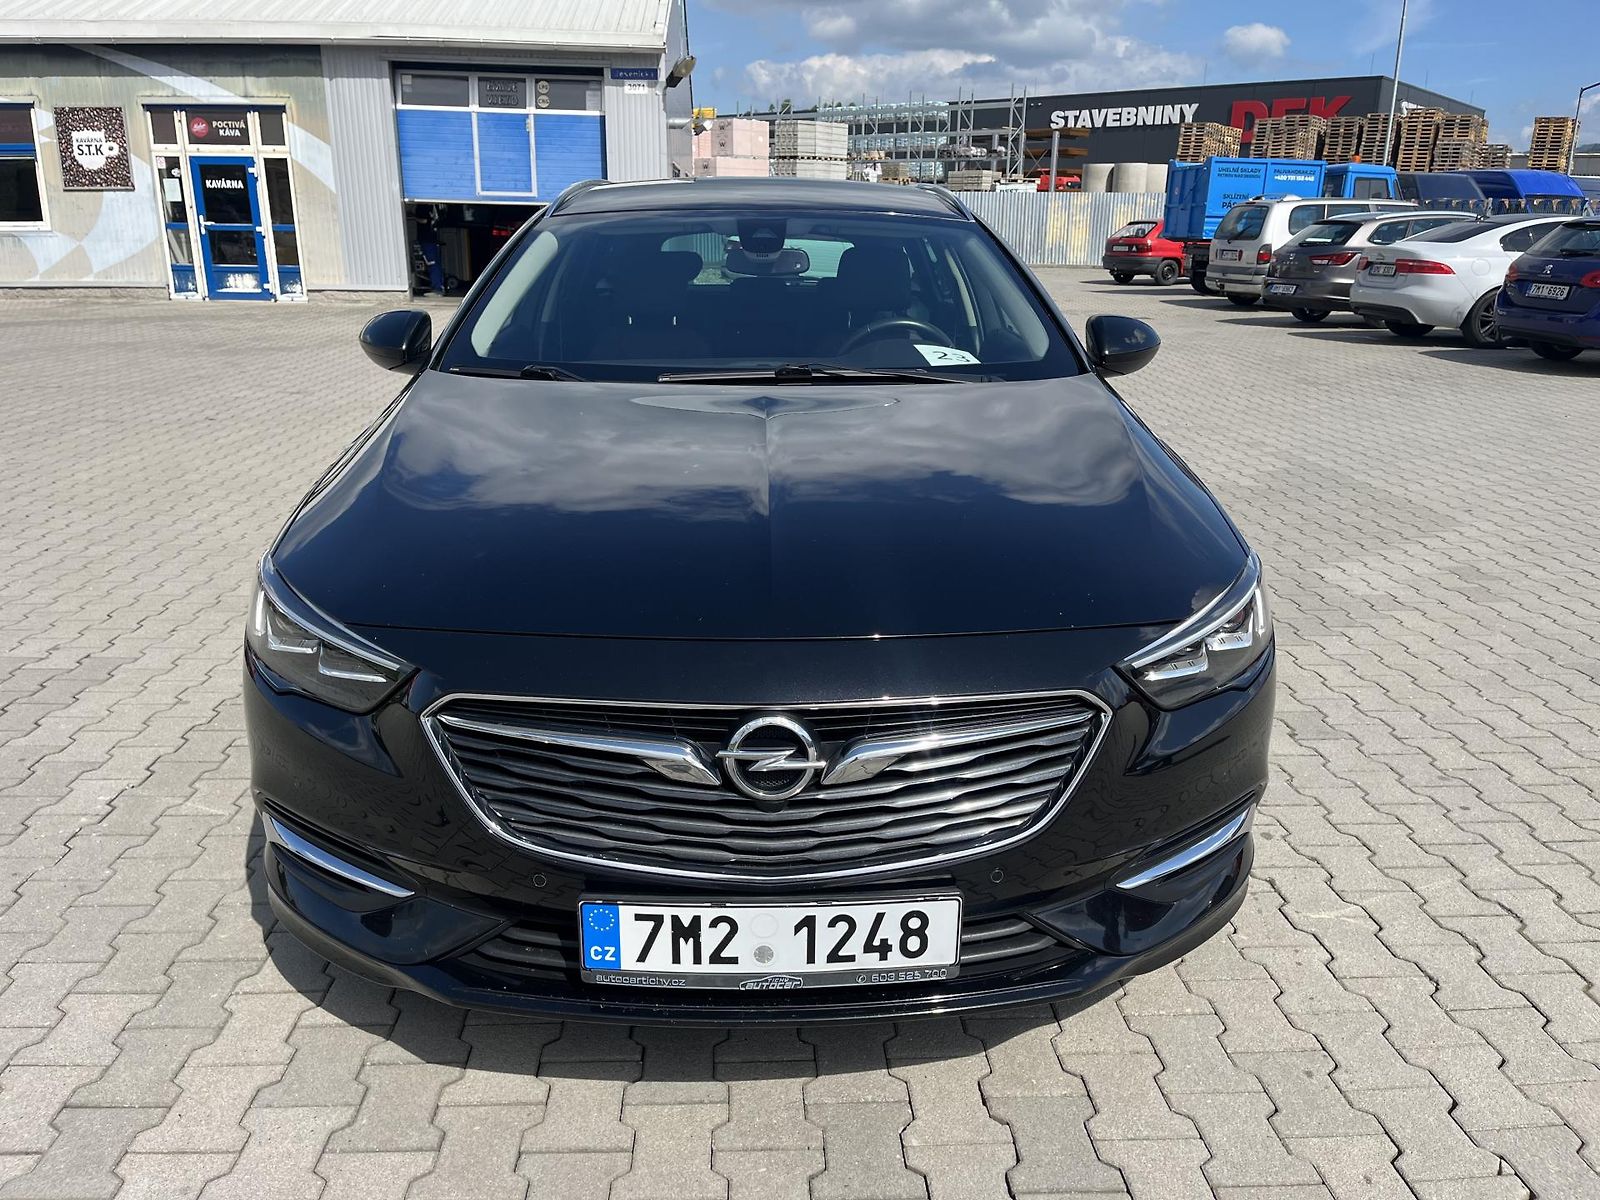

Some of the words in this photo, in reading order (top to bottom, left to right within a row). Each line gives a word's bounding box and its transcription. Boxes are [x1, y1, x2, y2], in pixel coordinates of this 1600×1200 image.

[1050, 103, 1200, 130] STAVEBNINY
[212, 119, 246, 129] POCTIVÁ
[219, 128, 241, 137] KÁVA
[205, 178, 245, 189] KAVÁRNA
[633, 913, 740, 966] 7M2
[793, 909, 930, 965] 1248
[589, 945, 616, 961] CZ
[595, 974, 686, 987] autocartichy.cz
[871, 972, 896, 983] 603
[924, 968, 948, 979] 700
